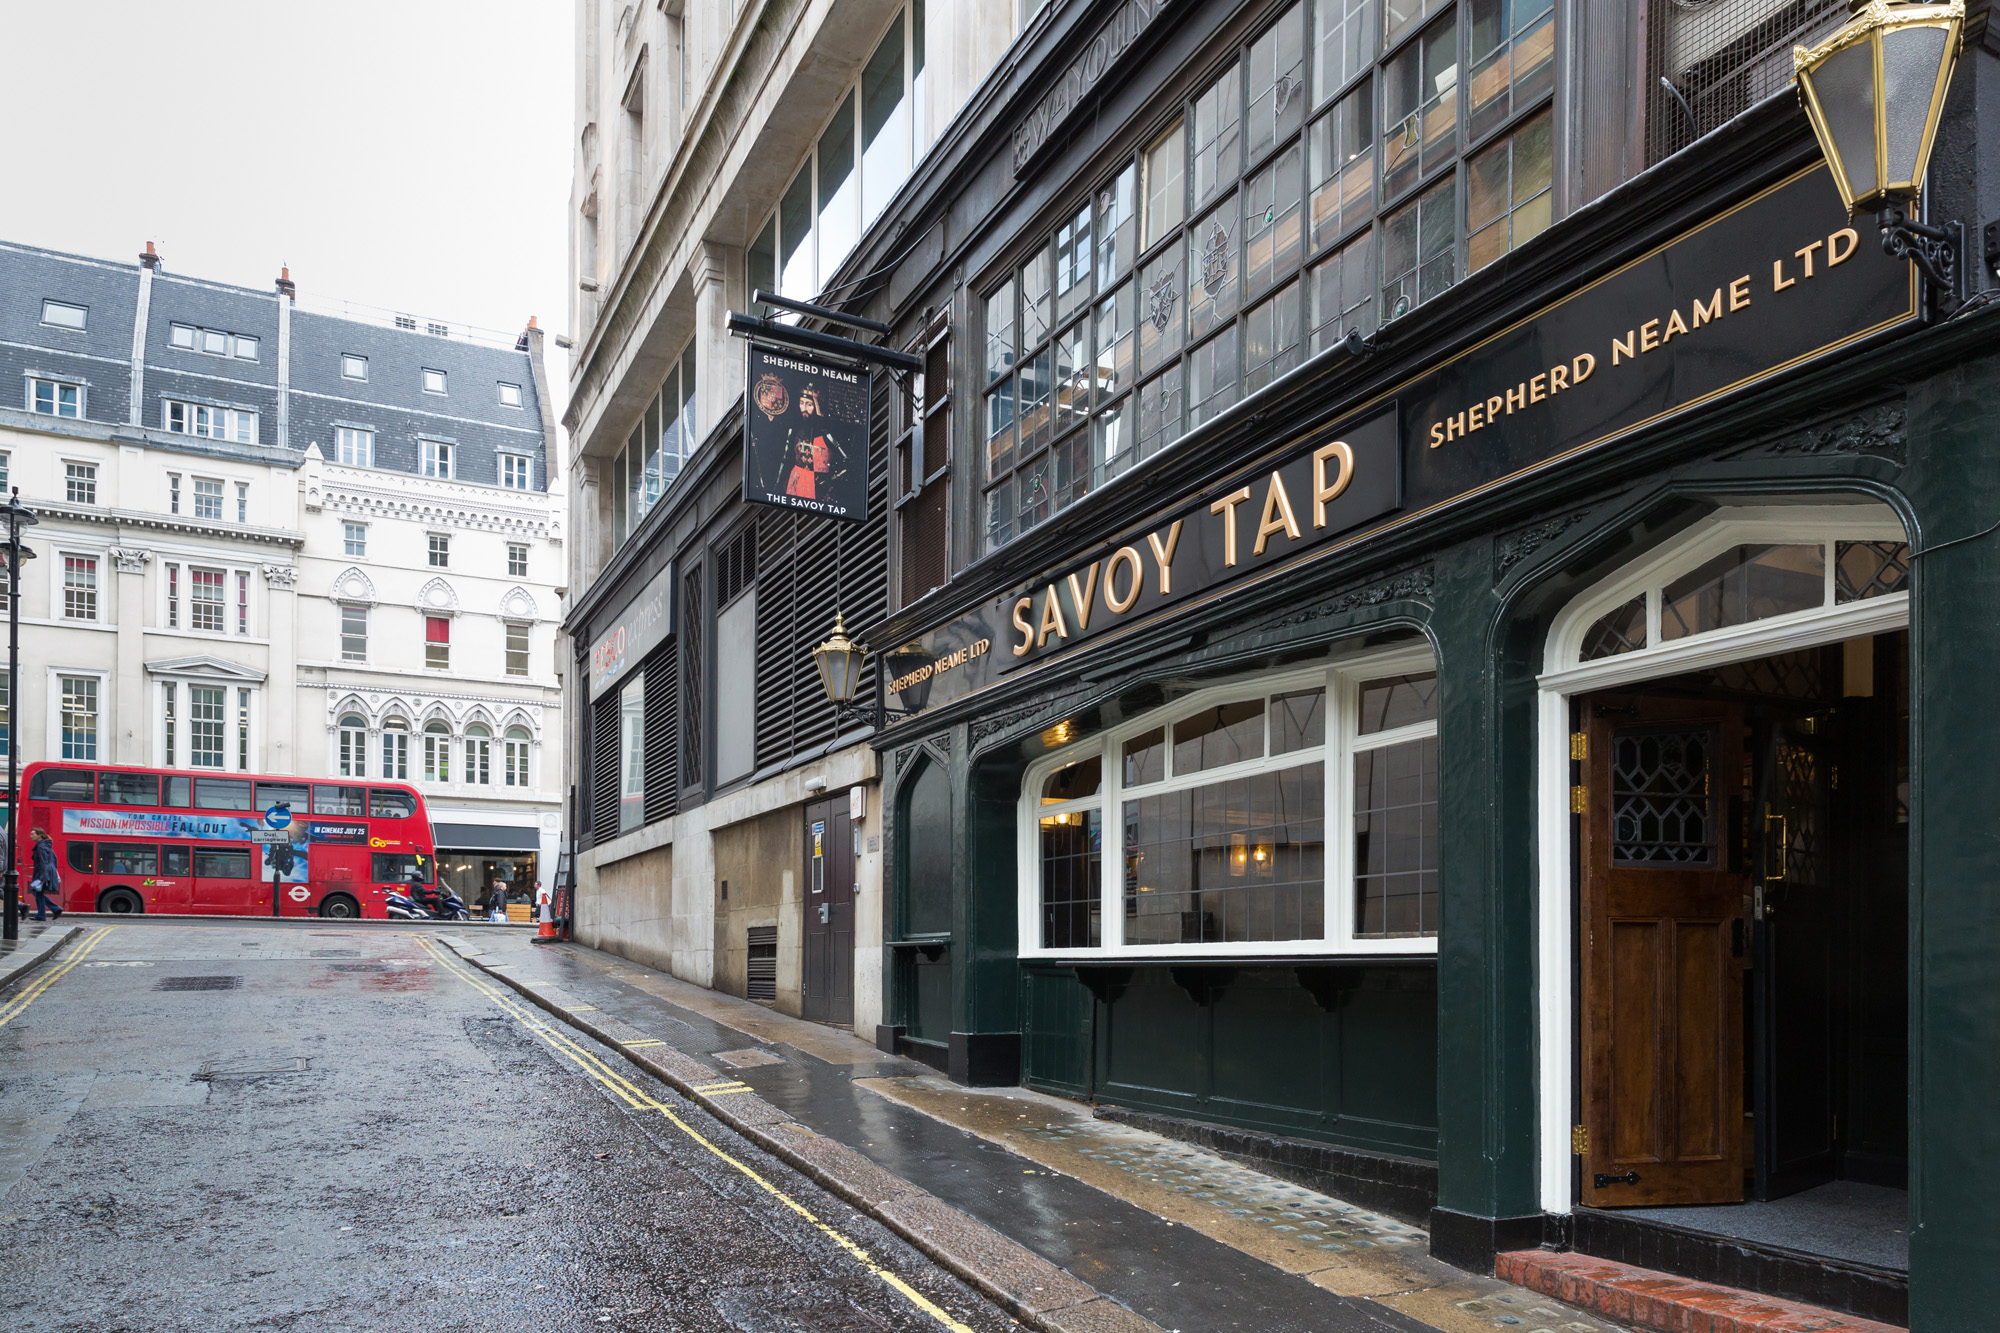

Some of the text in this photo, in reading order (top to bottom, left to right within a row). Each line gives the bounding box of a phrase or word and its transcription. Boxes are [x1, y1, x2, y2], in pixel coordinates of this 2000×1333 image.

[1430, 227, 1860, 450] SHEPHERD NEAME LTD
[763, 354, 858, 384] SHEPHERD NEAME
[766, 493, 847, 515] THE SAVOY TAP
[1012, 441, 1354, 657] SAVOY TAP
[594, 626, 626, 676] TESCO
[888, 638, 990, 695] SHEPHERD NEAME LTD
[152, 814, 182, 822] CRUISE
[313, 805, 393, 816] TARBUKS
[119, 819, 170, 832] IMPOSSIBLE
[172, 821, 228, 834] FALLOUT
[321, 826, 344, 835] CINEMAS
[344, 827, 357, 835] JULY
